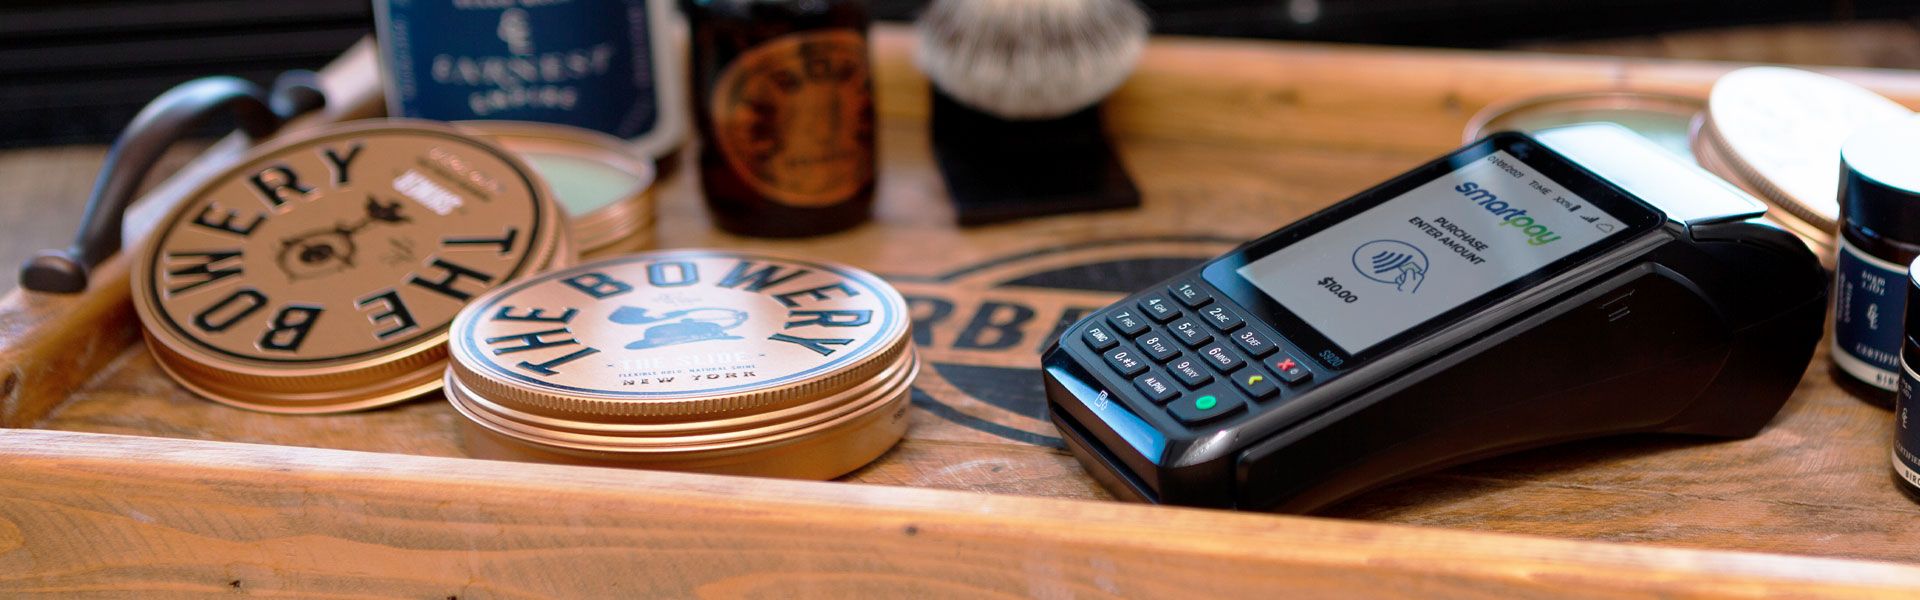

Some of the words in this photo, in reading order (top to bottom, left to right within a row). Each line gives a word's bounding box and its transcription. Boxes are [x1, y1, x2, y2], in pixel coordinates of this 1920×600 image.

[1455, 181, 1562, 247] smartpay
[1434, 216, 1489, 252] PURCHASE
[1408, 216, 1444, 240] ENTER
[1438, 235, 1487, 266] AMOUNT
[164, 143, 367, 352] BOWERY
[1317, 276, 1358, 304] $10.00
[1149, 298, 1161, 306] 4
[1116, 311, 1130, 319] 7
[1209, 307, 1222, 316] 2
[1214, 312, 1230, 323] ABC
[486, 305, 600, 377] THE
[559, 260, 873, 357] BOWERY
[1178, 322, 1191, 330] 5
[1089, 328, 1109, 342] FUNC
[1146, 337, 1159, 345] 8
[1240, 331, 1253, 340] 3
[1245, 336, 1261, 347] DEF
[1208, 347, 1221, 355] 6
[1214, 352, 1231, 365] MNO
[1319, 350, 1345, 367] S920
[1177, 361, 1190, 369] 9
[622, 376, 675, 386] NEW
[690, 370, 757, 382] YORK
[1182, 367, 1199, 378] WXY
[1144, 377, 1167, 394] ALPHA
